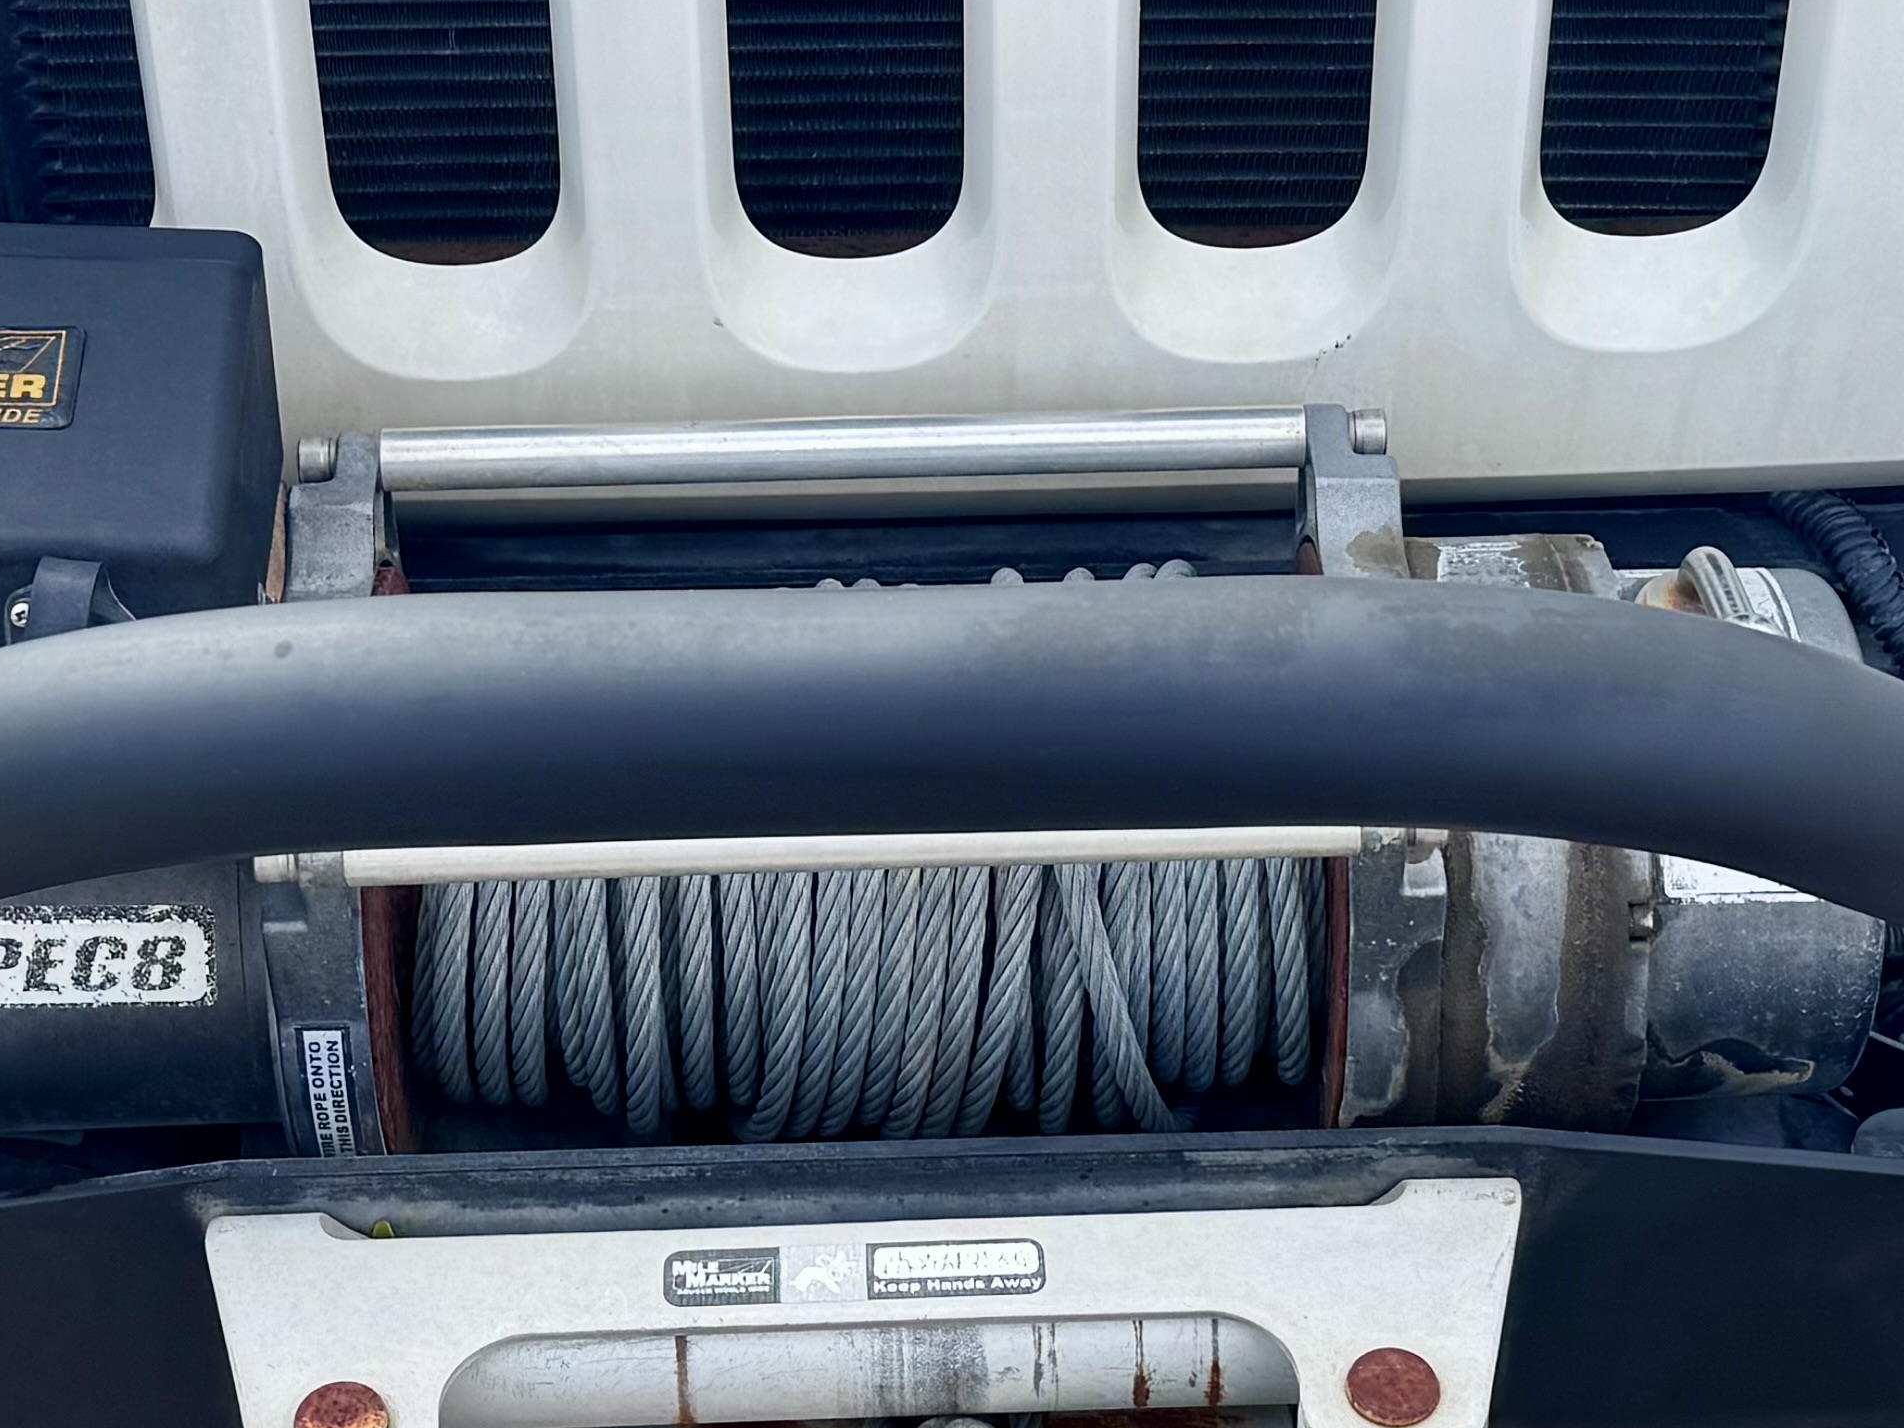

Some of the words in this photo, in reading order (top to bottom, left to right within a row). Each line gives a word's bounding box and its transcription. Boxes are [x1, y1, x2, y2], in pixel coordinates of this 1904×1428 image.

[308, 1041, 325, 1089] ONTO
[326, 1040, 348, 1122] DIRECTION
[313, 1092, 332, 1130] ROPE
[336, 1124, 353, 1154] THIS
[686, 1272, 771, 1288] MARKER
[873, 1280, 921, 1294] Keep
[926, 1277, 985, 1291] Hands
[990, 1276, 1042, 1290] Away
